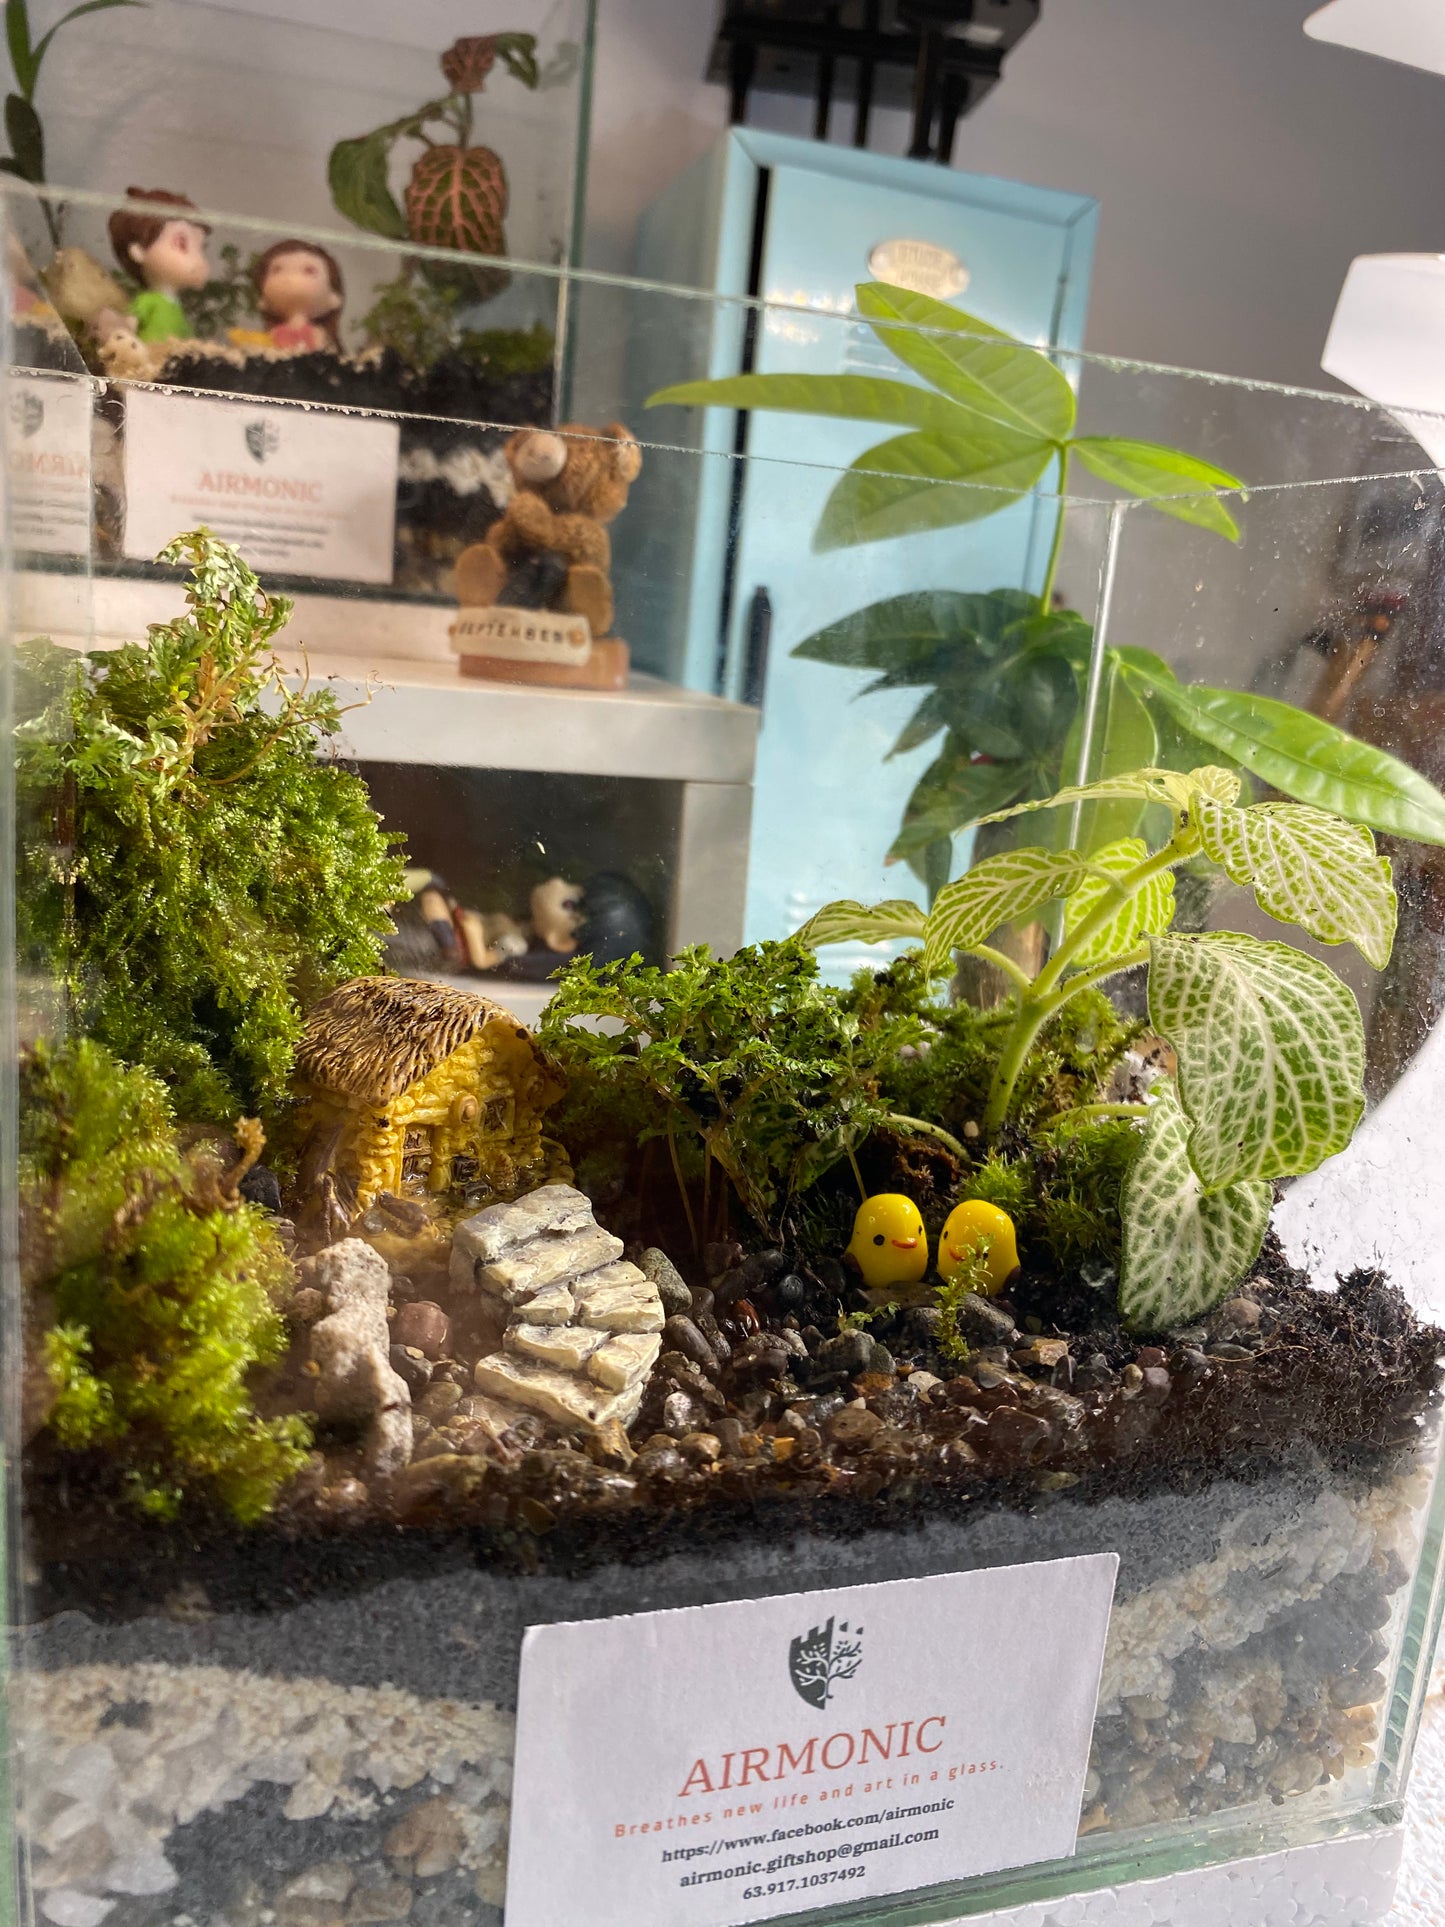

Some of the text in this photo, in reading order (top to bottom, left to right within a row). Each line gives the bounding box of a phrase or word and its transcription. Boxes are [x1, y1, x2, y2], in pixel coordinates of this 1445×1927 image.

[197, 469, 322, 502] AIRMONIC
[458, 621, 565, 644] SEPTEMBER
[677, 1715, 947, 1798] AIRMONIC
[613, 1759, 1004, 1838] Breathes new life and art in a glass.
[661, 1797, 955, 1863] https://www.facebook.com/airmonic
[679, 1827, 940, 1888] airmonic.giftshop@gmail.com
[742, 1865, 866, 1900] 63.917.1037492
